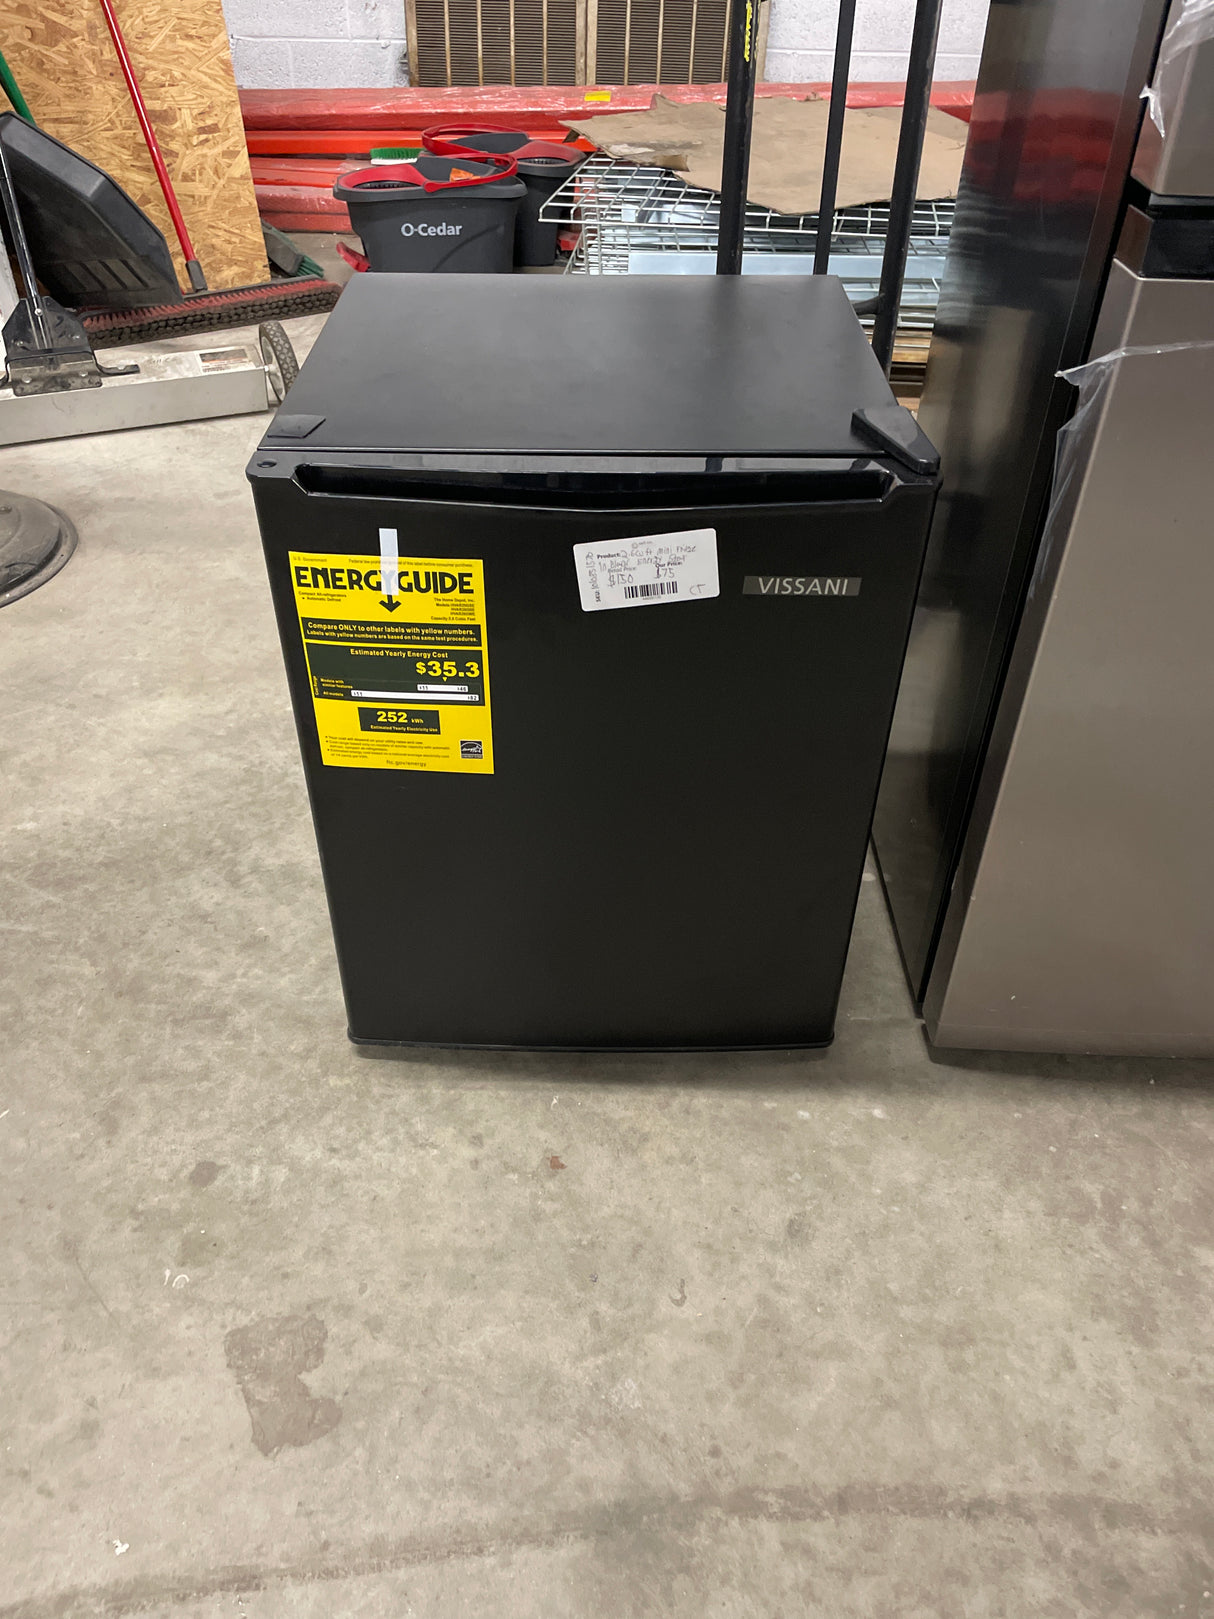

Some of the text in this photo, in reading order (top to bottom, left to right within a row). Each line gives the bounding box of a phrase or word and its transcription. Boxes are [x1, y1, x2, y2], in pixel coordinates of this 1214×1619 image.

[401, 222, 462, 237] O-Cedar
[597, 552, 620, 560] Product:
[758, 577, 849, 596] VISSANI
[308, 621, 337, 630] Compare
[421, 627, 442, 635] yellow
[350, 648, 384, 656] Estimated
[385, 649, 406, 658] Yearly
[407, 650, 431, 659] Energy
[416, 660, 480, 678] $35.3
[376, 711, 408, 723] 252
